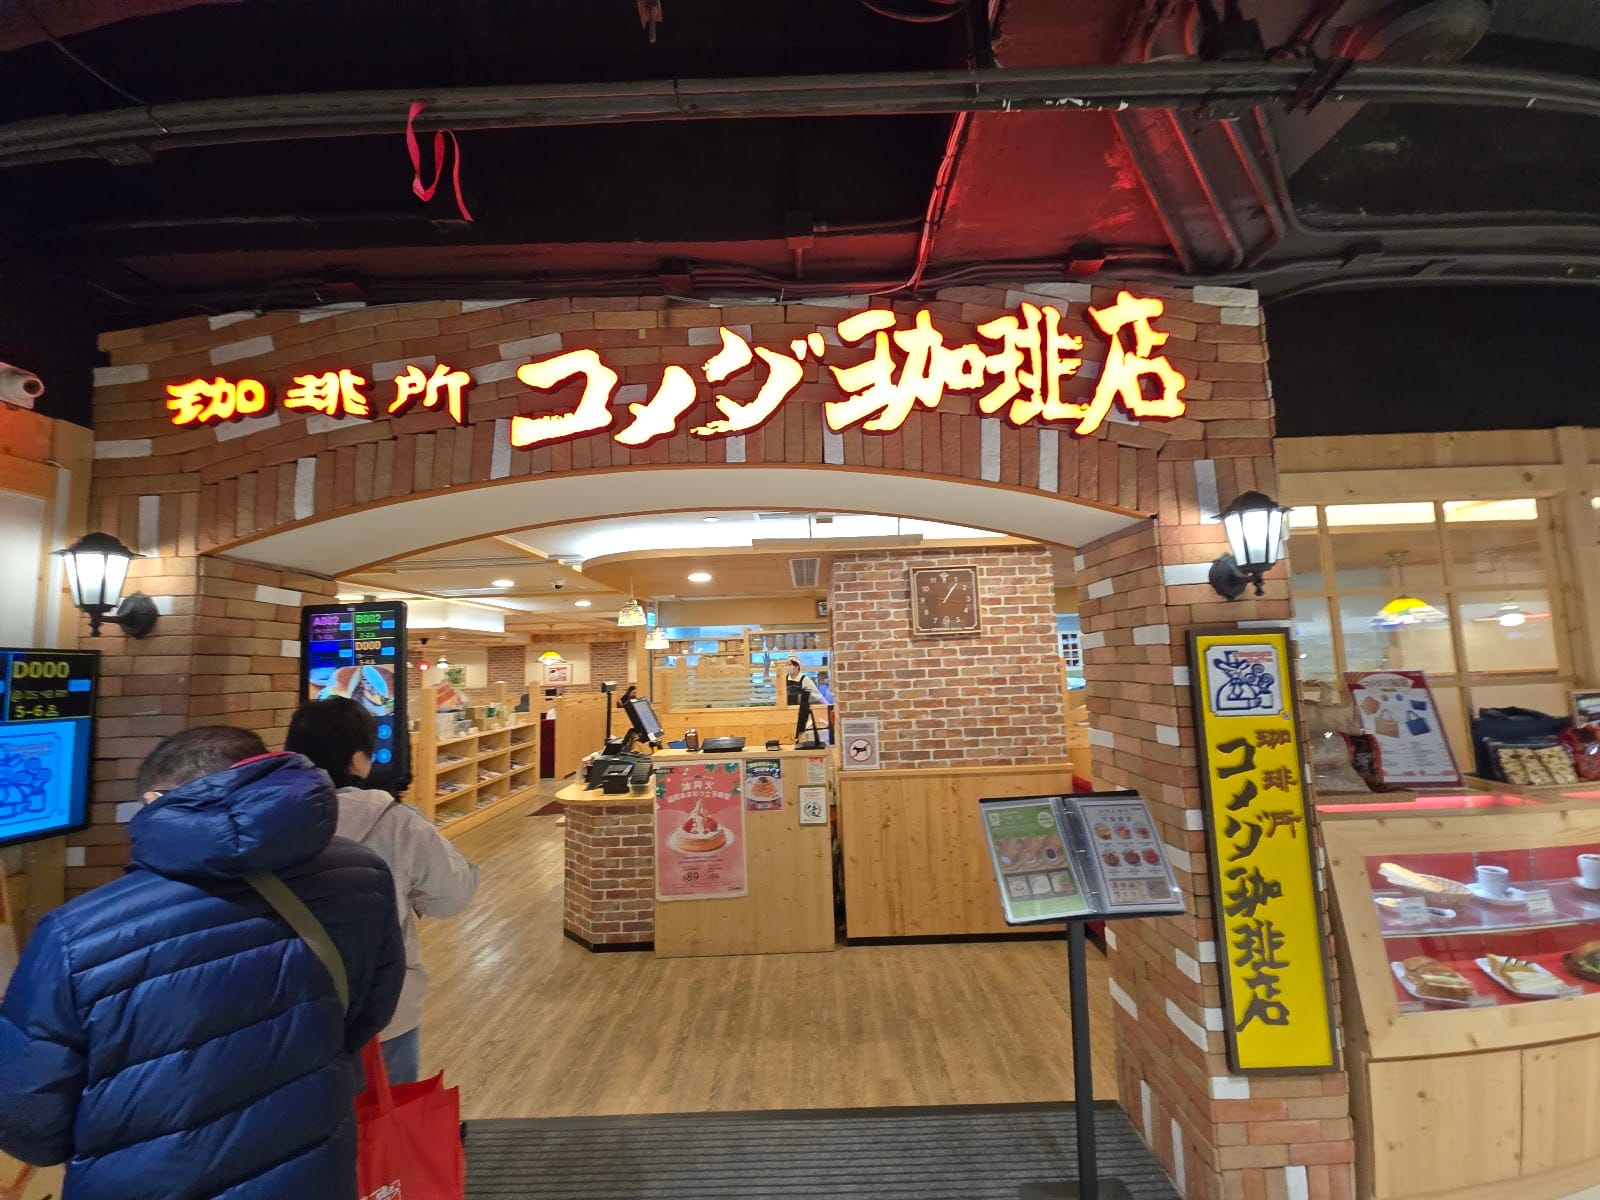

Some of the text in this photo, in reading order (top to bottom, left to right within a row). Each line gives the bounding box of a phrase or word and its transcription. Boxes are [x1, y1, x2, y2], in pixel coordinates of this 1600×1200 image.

[166, 291, 1188, 449] 珈琲所 コメダ珈琲店
[12, 661, 70, 679] D000
[1215, 737, 1290, 1033] コメダ珈琲店
